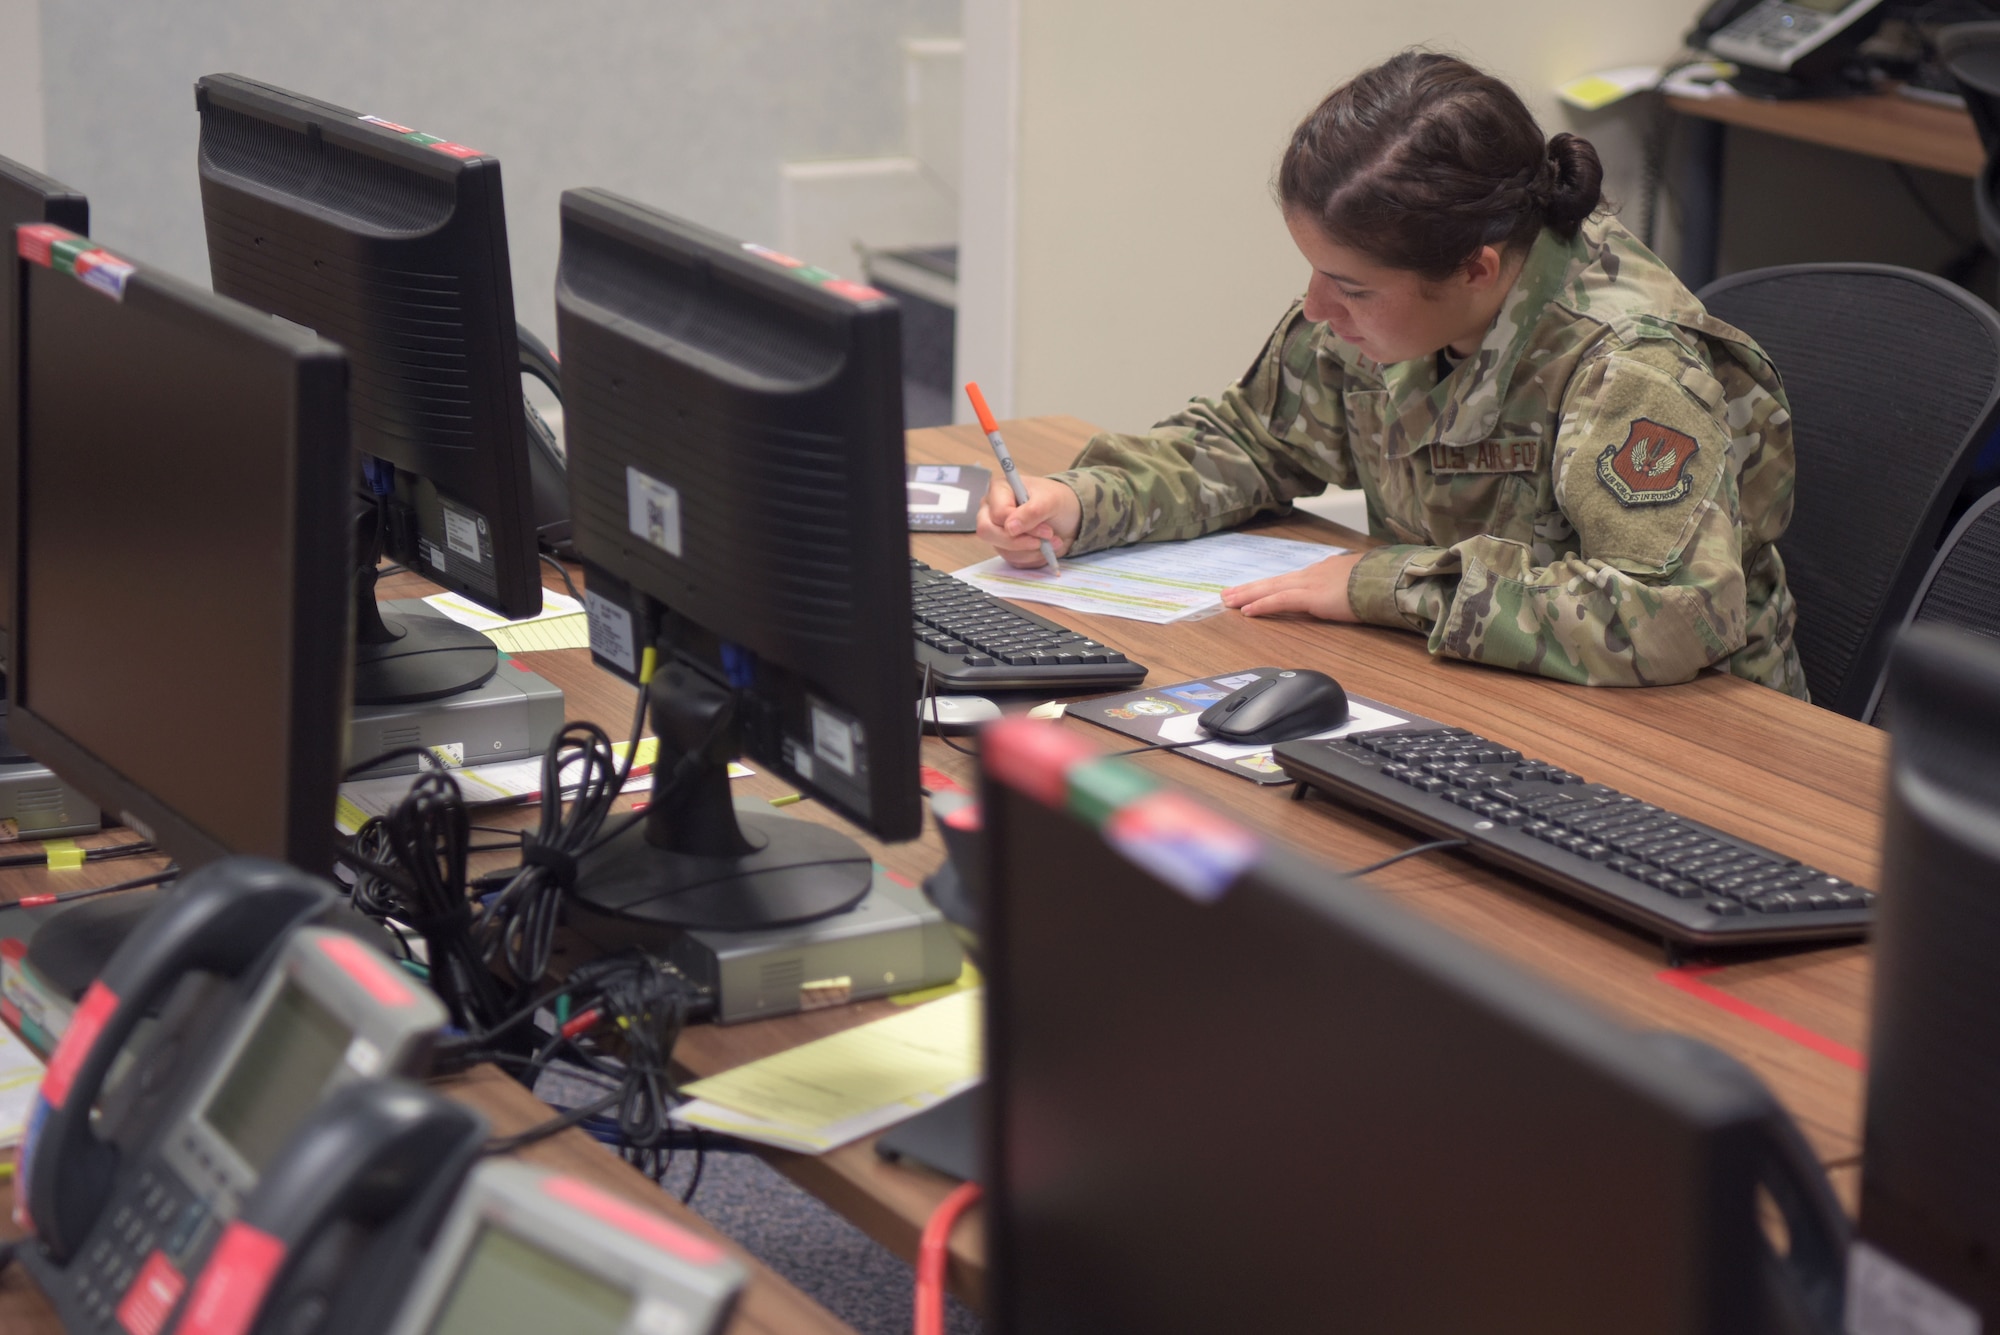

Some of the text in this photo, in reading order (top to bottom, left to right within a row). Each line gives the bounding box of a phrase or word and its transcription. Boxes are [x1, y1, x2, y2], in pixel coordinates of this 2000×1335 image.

[1477, 442, 1505, 469] AIR
[1603, 473, 1616, 486] AIR
[1613, 481, 1640, 500] FORCES
[1651, 487, 1682, 500] EUROPE
